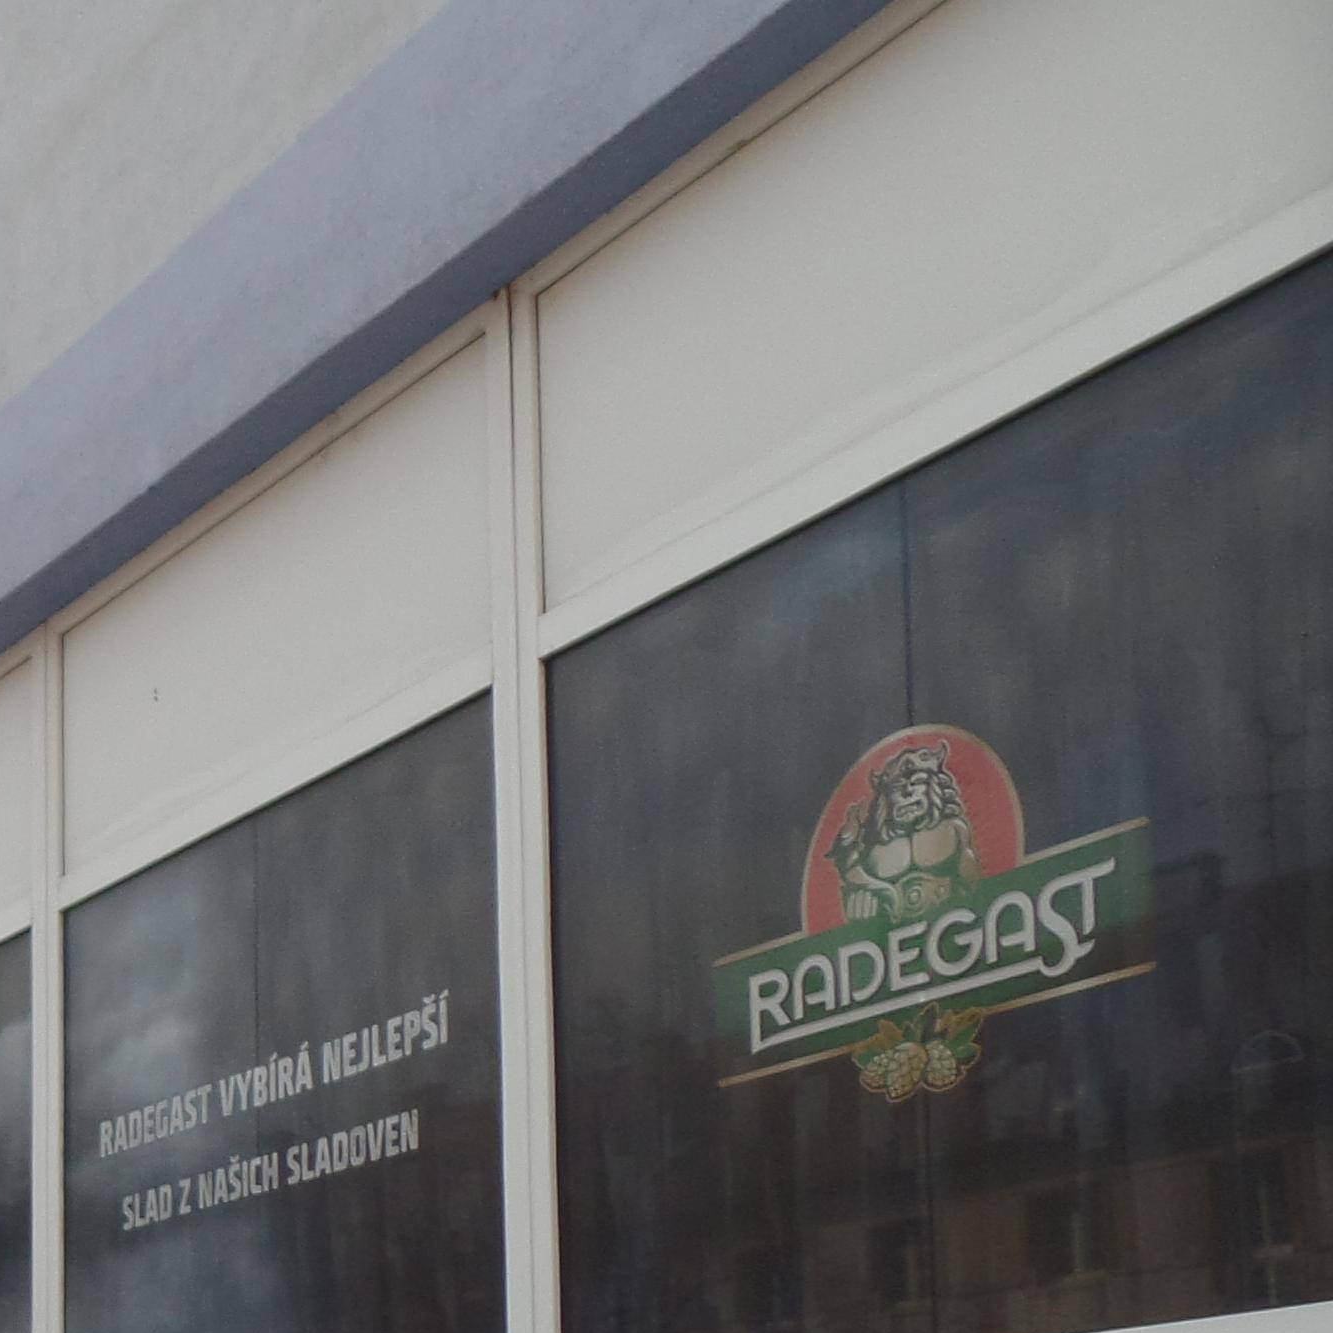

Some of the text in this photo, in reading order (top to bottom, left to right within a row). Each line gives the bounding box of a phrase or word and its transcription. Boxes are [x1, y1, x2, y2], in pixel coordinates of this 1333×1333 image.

[749, 857, 1115, 1055] RADEGAST
[99, 989, 449, 1158] RADEGAST VYBÍRÁ NEJLEPŠÍ
[123, 1108, 420, 1230] SLAD Z NAŠICH SLADOVEN
